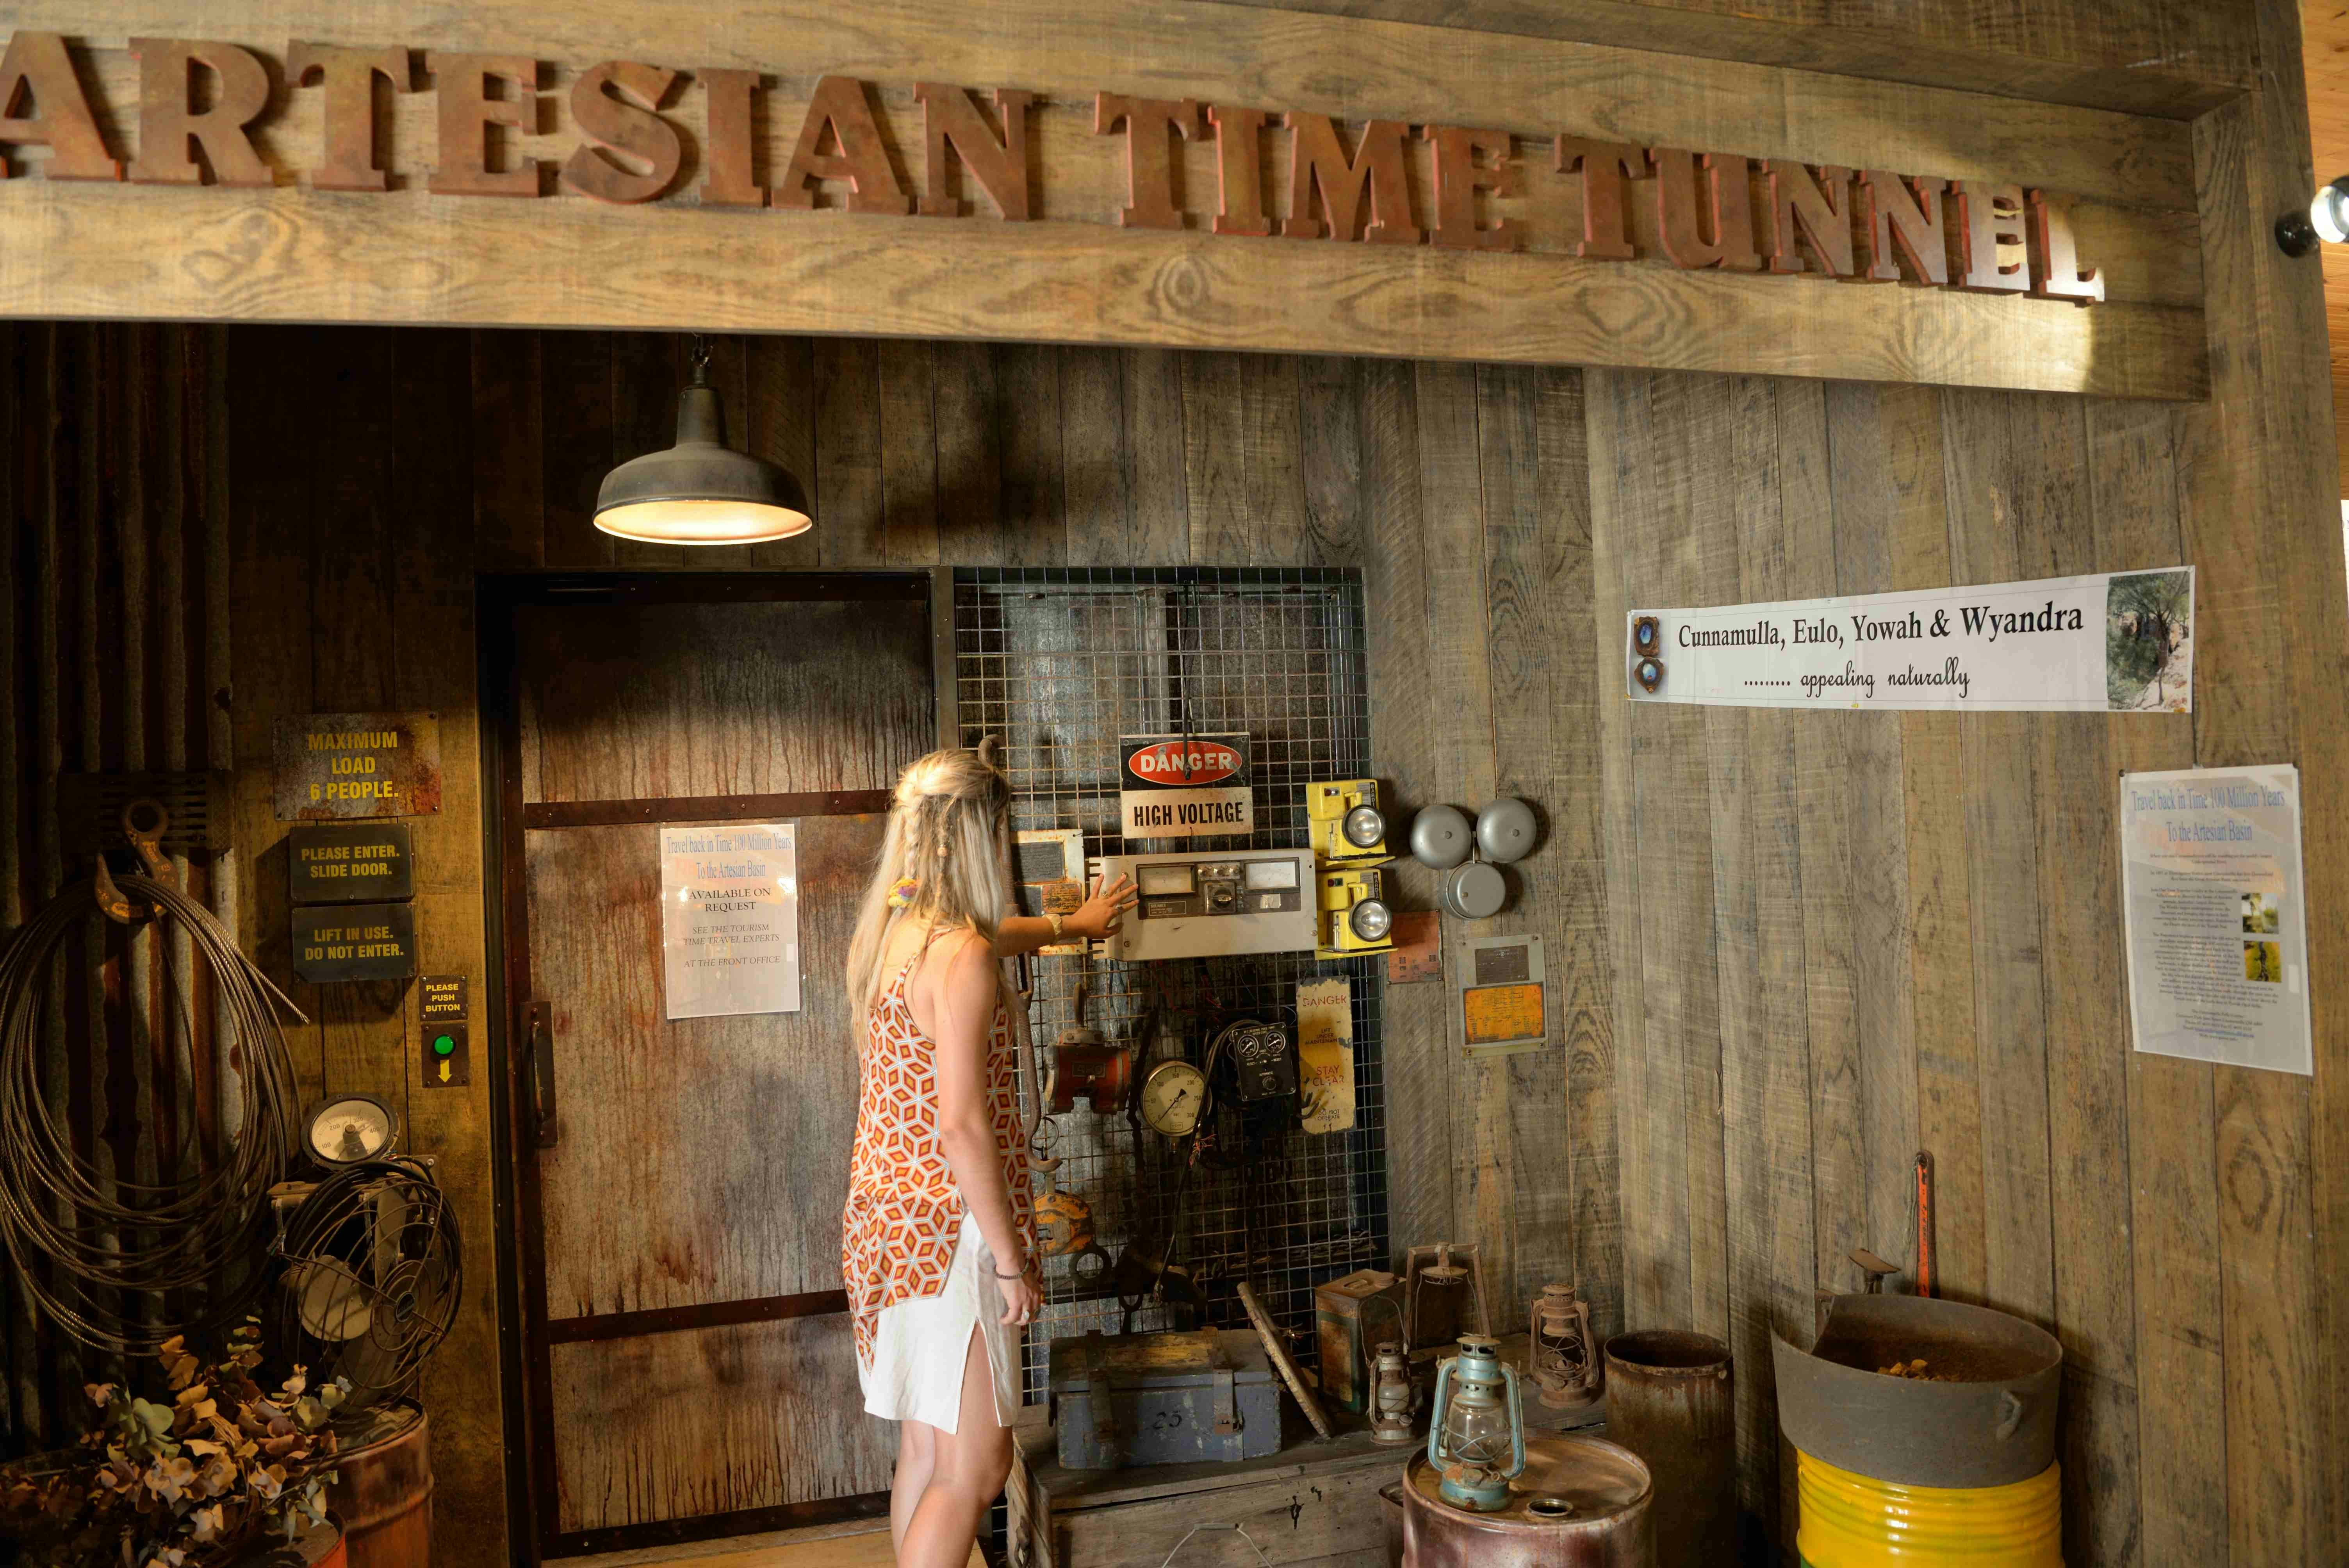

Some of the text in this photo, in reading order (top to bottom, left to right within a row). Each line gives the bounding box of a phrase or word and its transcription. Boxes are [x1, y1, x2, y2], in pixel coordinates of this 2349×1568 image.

[0, 30, 2105, 303] ARTESIAN TIME TUNNEL
[1679, 600, 2084, 651] Cunnamulla, Eulo, Yowah & Wyandra
[1800, 660, 1875, 698] appealing
[1887, 656, 1970, 698] naturally
[308, 731, 397, 750] MAXIMUM
[332, 756, 376, 774] LOAD
[1140, 752, 1232, 772] DANGER
[310, 781, 399, 800] 6 PEOPLE.
[2130, 785, 2285, 812] Travel back in Time 100 Million Years
[1134, 802, 1244, 827] HIGH VOLTAGE
[2166, 819, 2253, 842] To the Artesian Basin
[666, 832, 792, 853] Travel back in Time 100 Million Years
[301, 845, 400, 861] PLEASE ENTER.
[310, 862, 392, 878] SLIDE DOOR.
[696, 859, 766, 879] To the Artesian Basin
[689, 888, 771, 900] AVAILABLE ON
[705, 901, 756, 912] REQUEST
[314, 926, 394, 942] LIFT IN USE.
[693, 923, 769, 934] SEE THE TOURISM
[708, 935, 741, 944] TRAVEL
[743, 934, 781, 943] EXPERTS
[305, 943, 404, 960] DO NOT ENTER.
[684, 955, 781, 968] AT THE FRONT OFFICE
[426, 984, 459, 992] PLEASE
[431, 994, 455, 1002] PUSH
[1303, 995, 1346, 1007] DANGER
[425, 1003, 460, 1012] BUTTON
[1316, 1065, 1340, 1076] STAY
[1312, 1075, 1344, 1087] CLEAR
